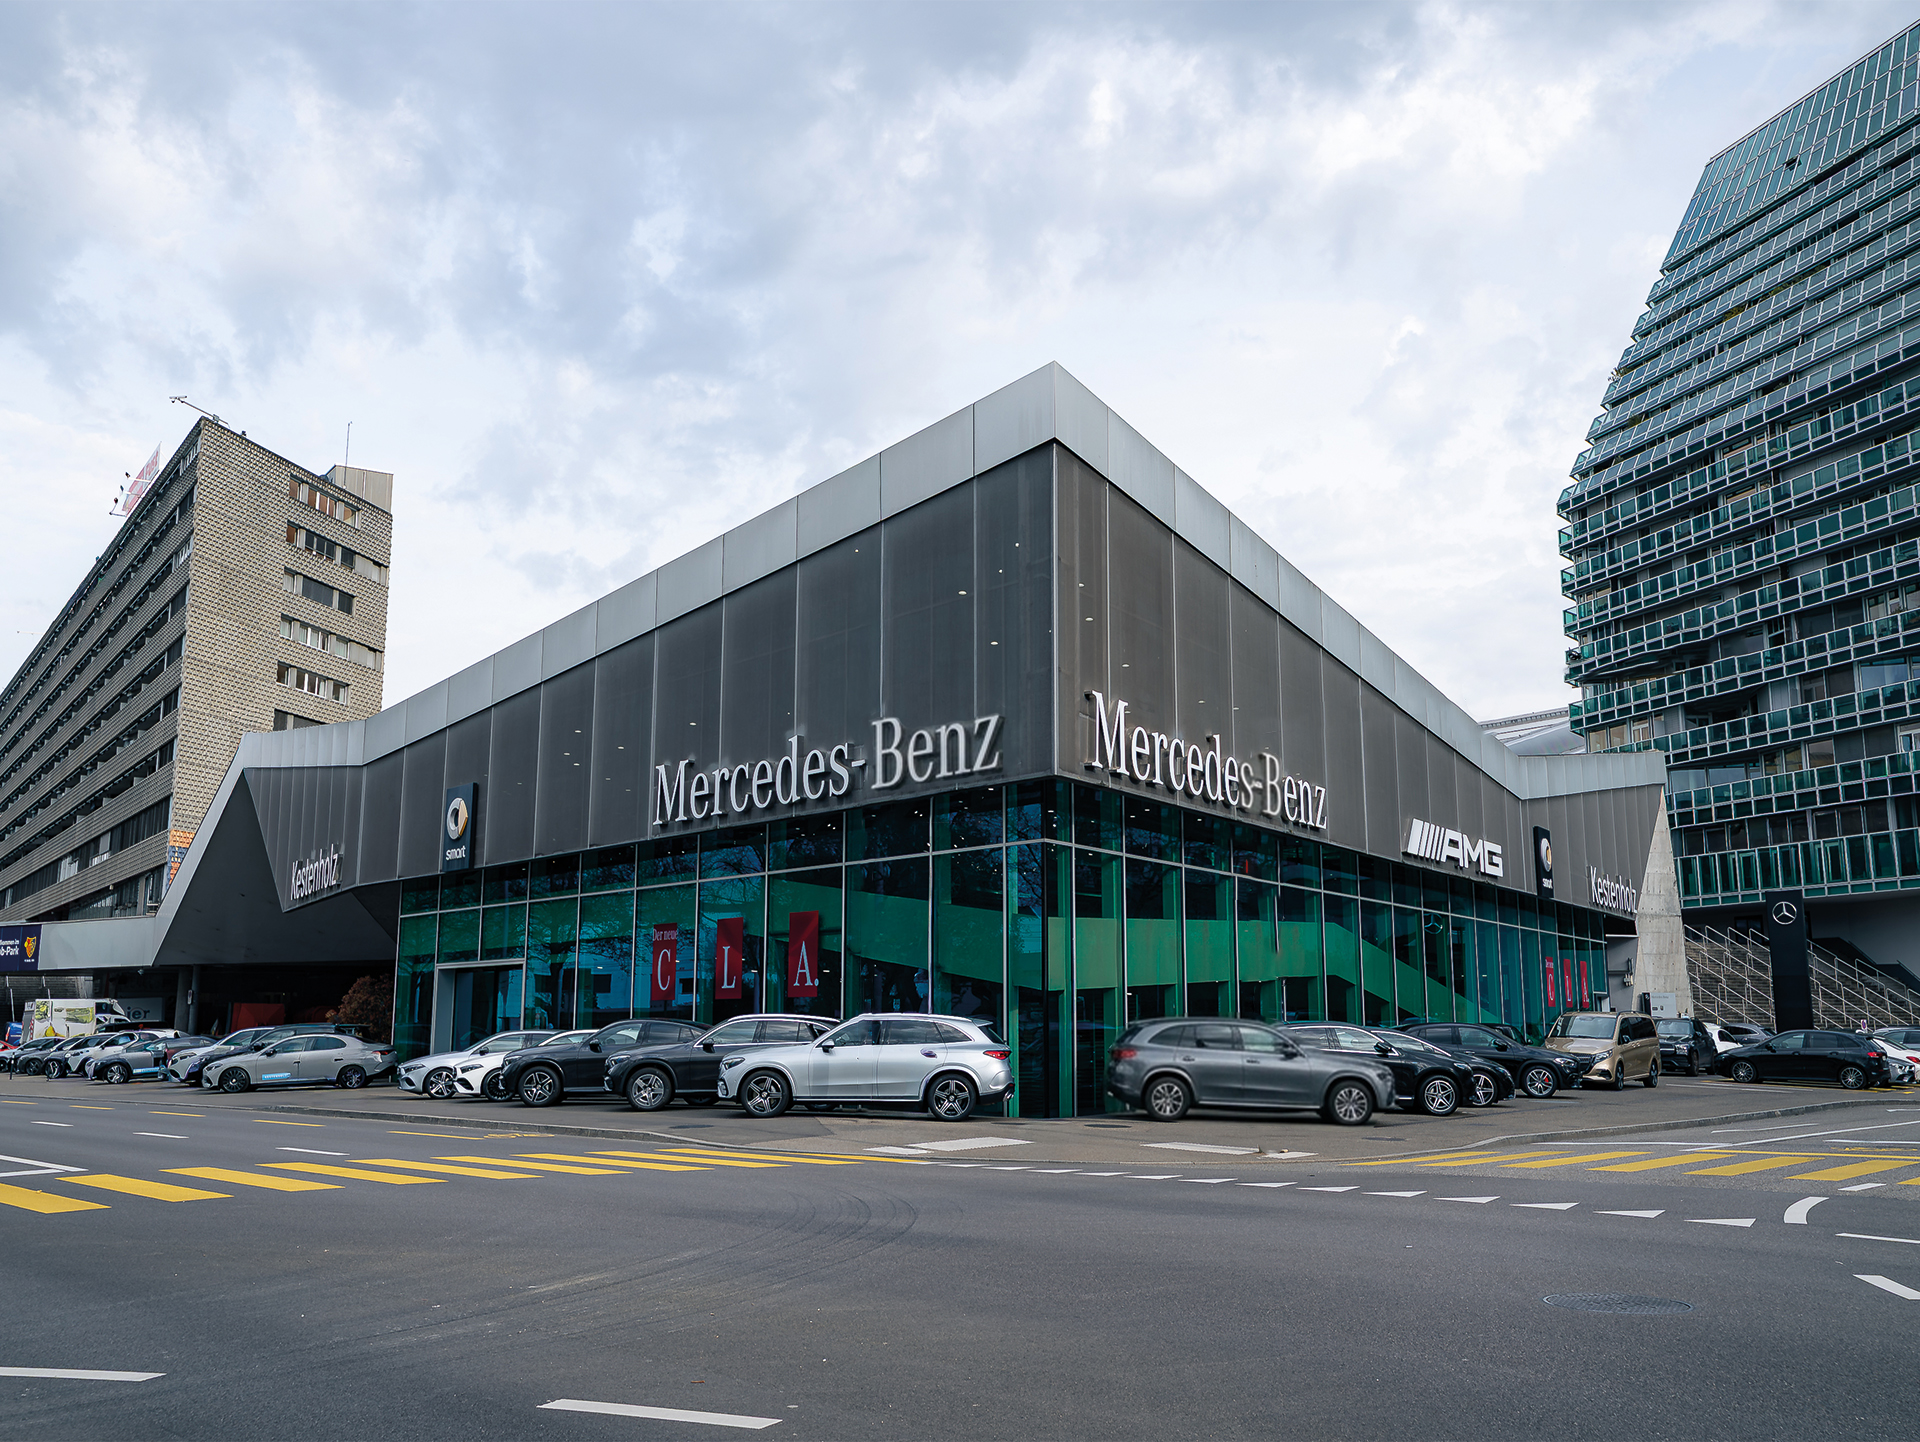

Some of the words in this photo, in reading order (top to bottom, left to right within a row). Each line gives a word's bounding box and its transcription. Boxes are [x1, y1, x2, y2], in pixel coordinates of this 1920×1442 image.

[653, 714, 1002, 826] Mercedes-Benz
[1091, 689, 1327, 829] Mercedes-Benz
[291, 843, 339, 900] Kestenholz
[445, 845, 466, 861] smart
[1590, 865, 1638, 913] Kestenholz
[657, 949, 671, 991] C
[721, 946, 736, 989] L
